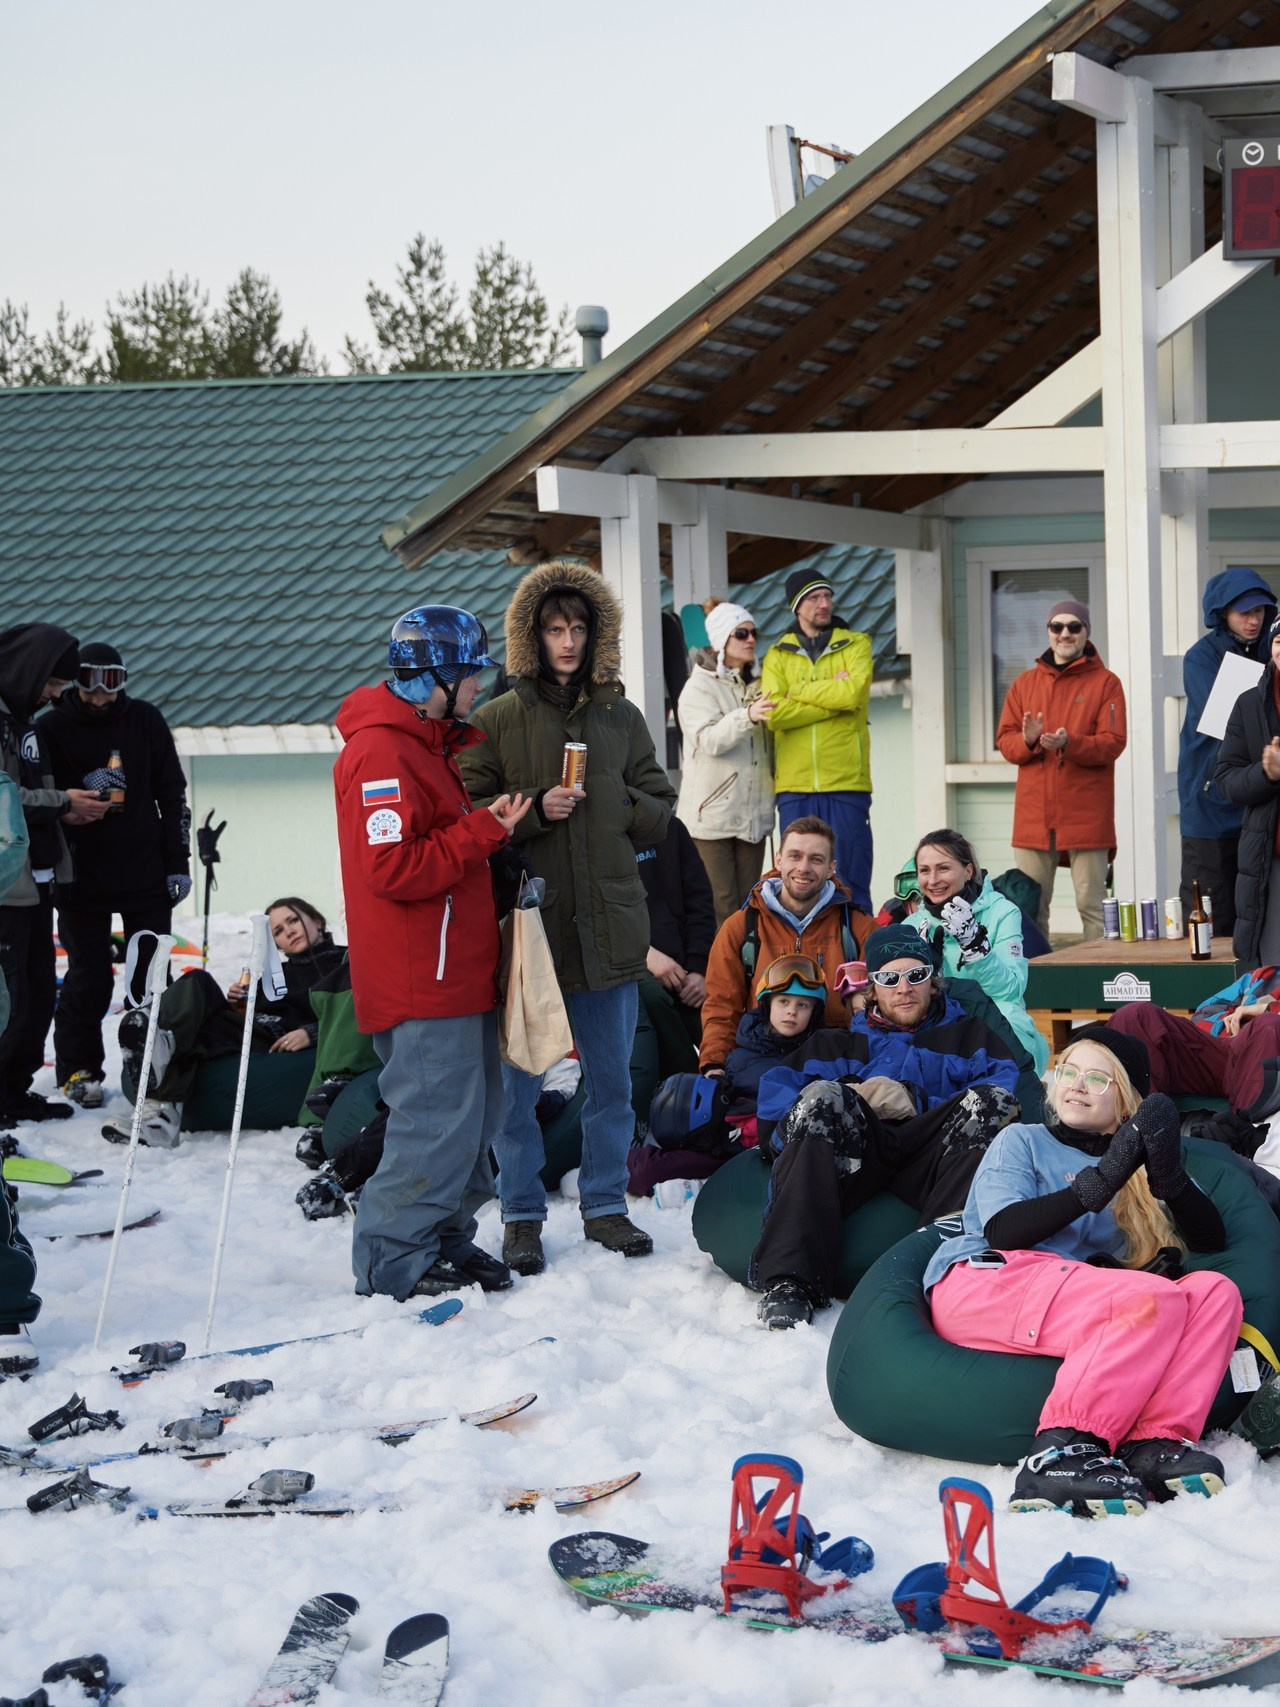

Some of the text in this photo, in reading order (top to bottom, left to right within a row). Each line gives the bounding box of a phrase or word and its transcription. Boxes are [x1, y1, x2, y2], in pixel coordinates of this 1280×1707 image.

[1105, 986, 1150, 996] AHMAD TEA
[42, 1417, 64, 1434] LOOK
